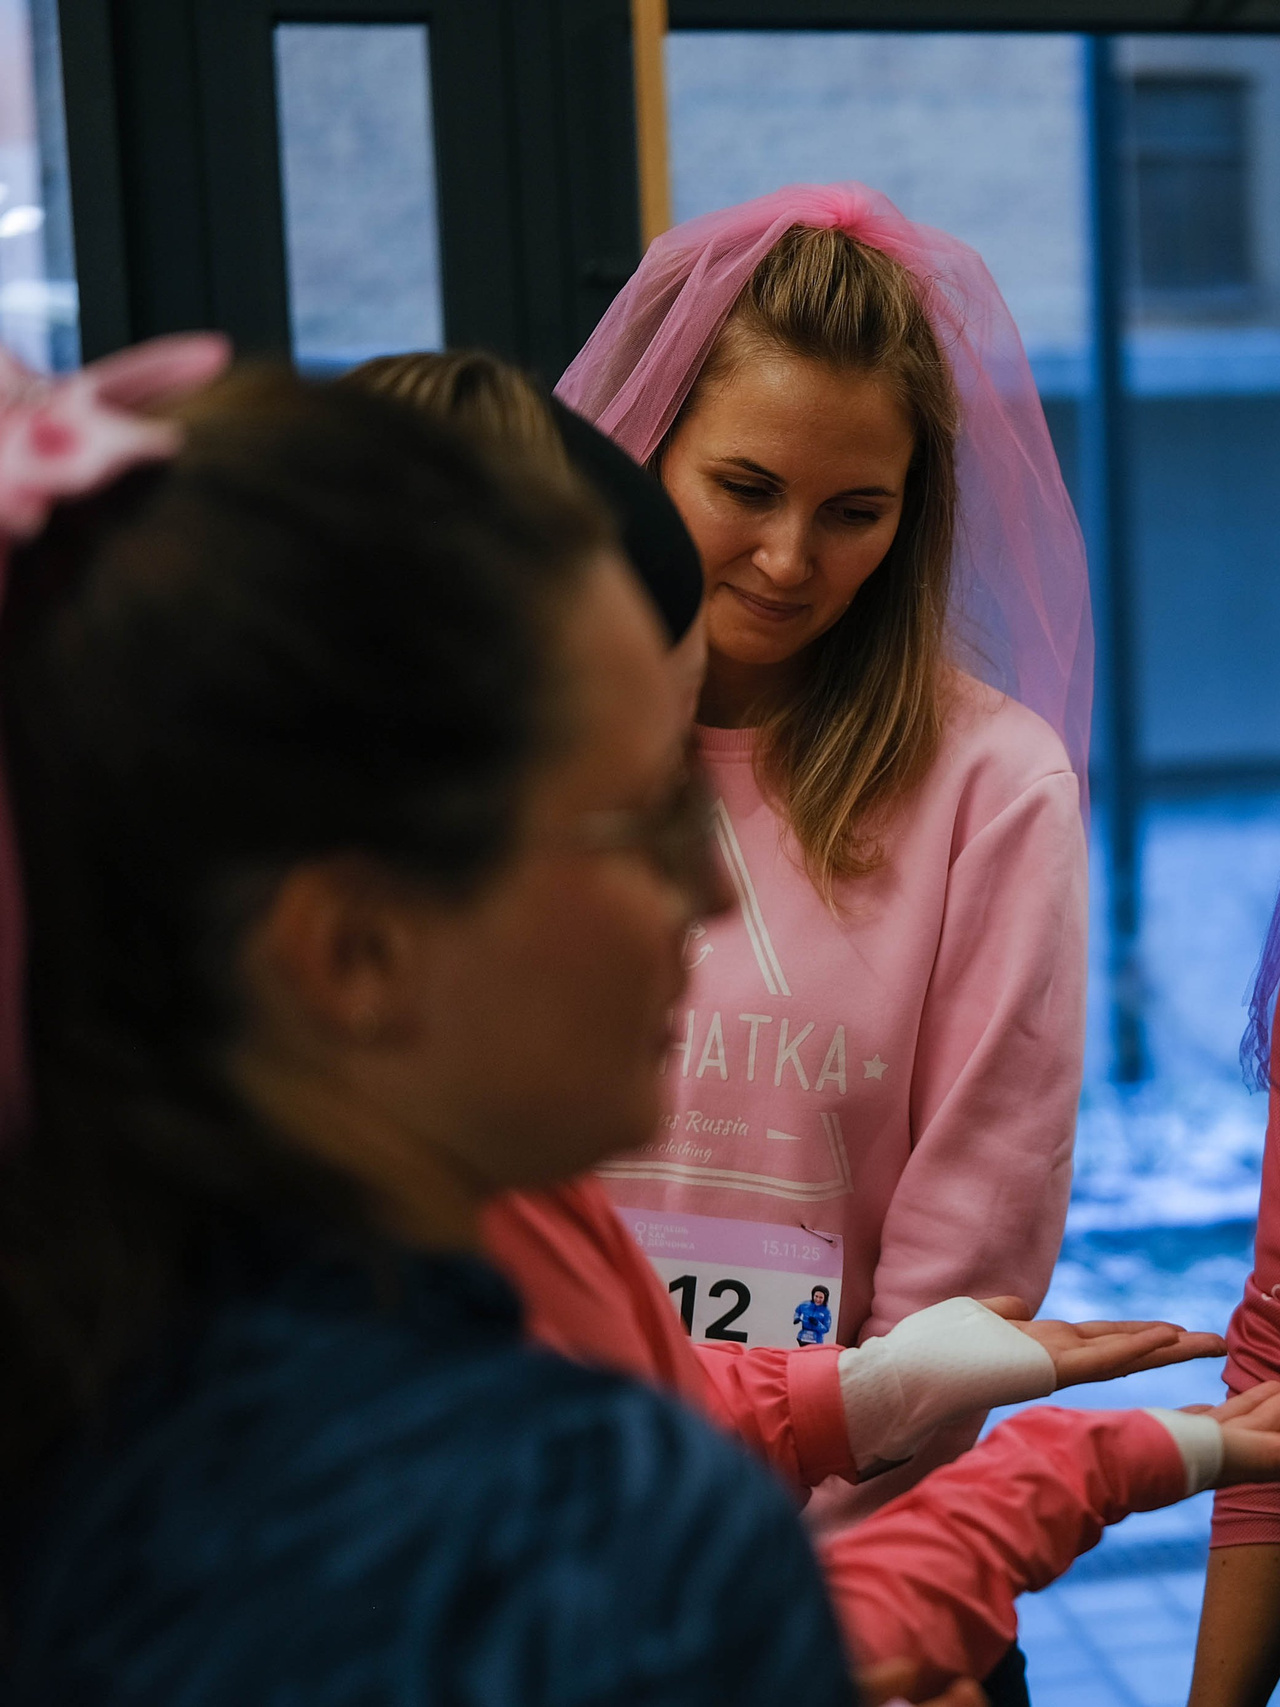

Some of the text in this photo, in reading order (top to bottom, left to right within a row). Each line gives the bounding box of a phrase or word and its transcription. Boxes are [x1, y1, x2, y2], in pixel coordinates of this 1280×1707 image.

[657, 1009, 847, 1095] HATKA
[685, 1110, 749, 1137] Russia
[658, 1138, 713, 1163] clothing
[762, 1240, 821, 1261] 15.11.25
[668, 1275, 752, 1343] 12
